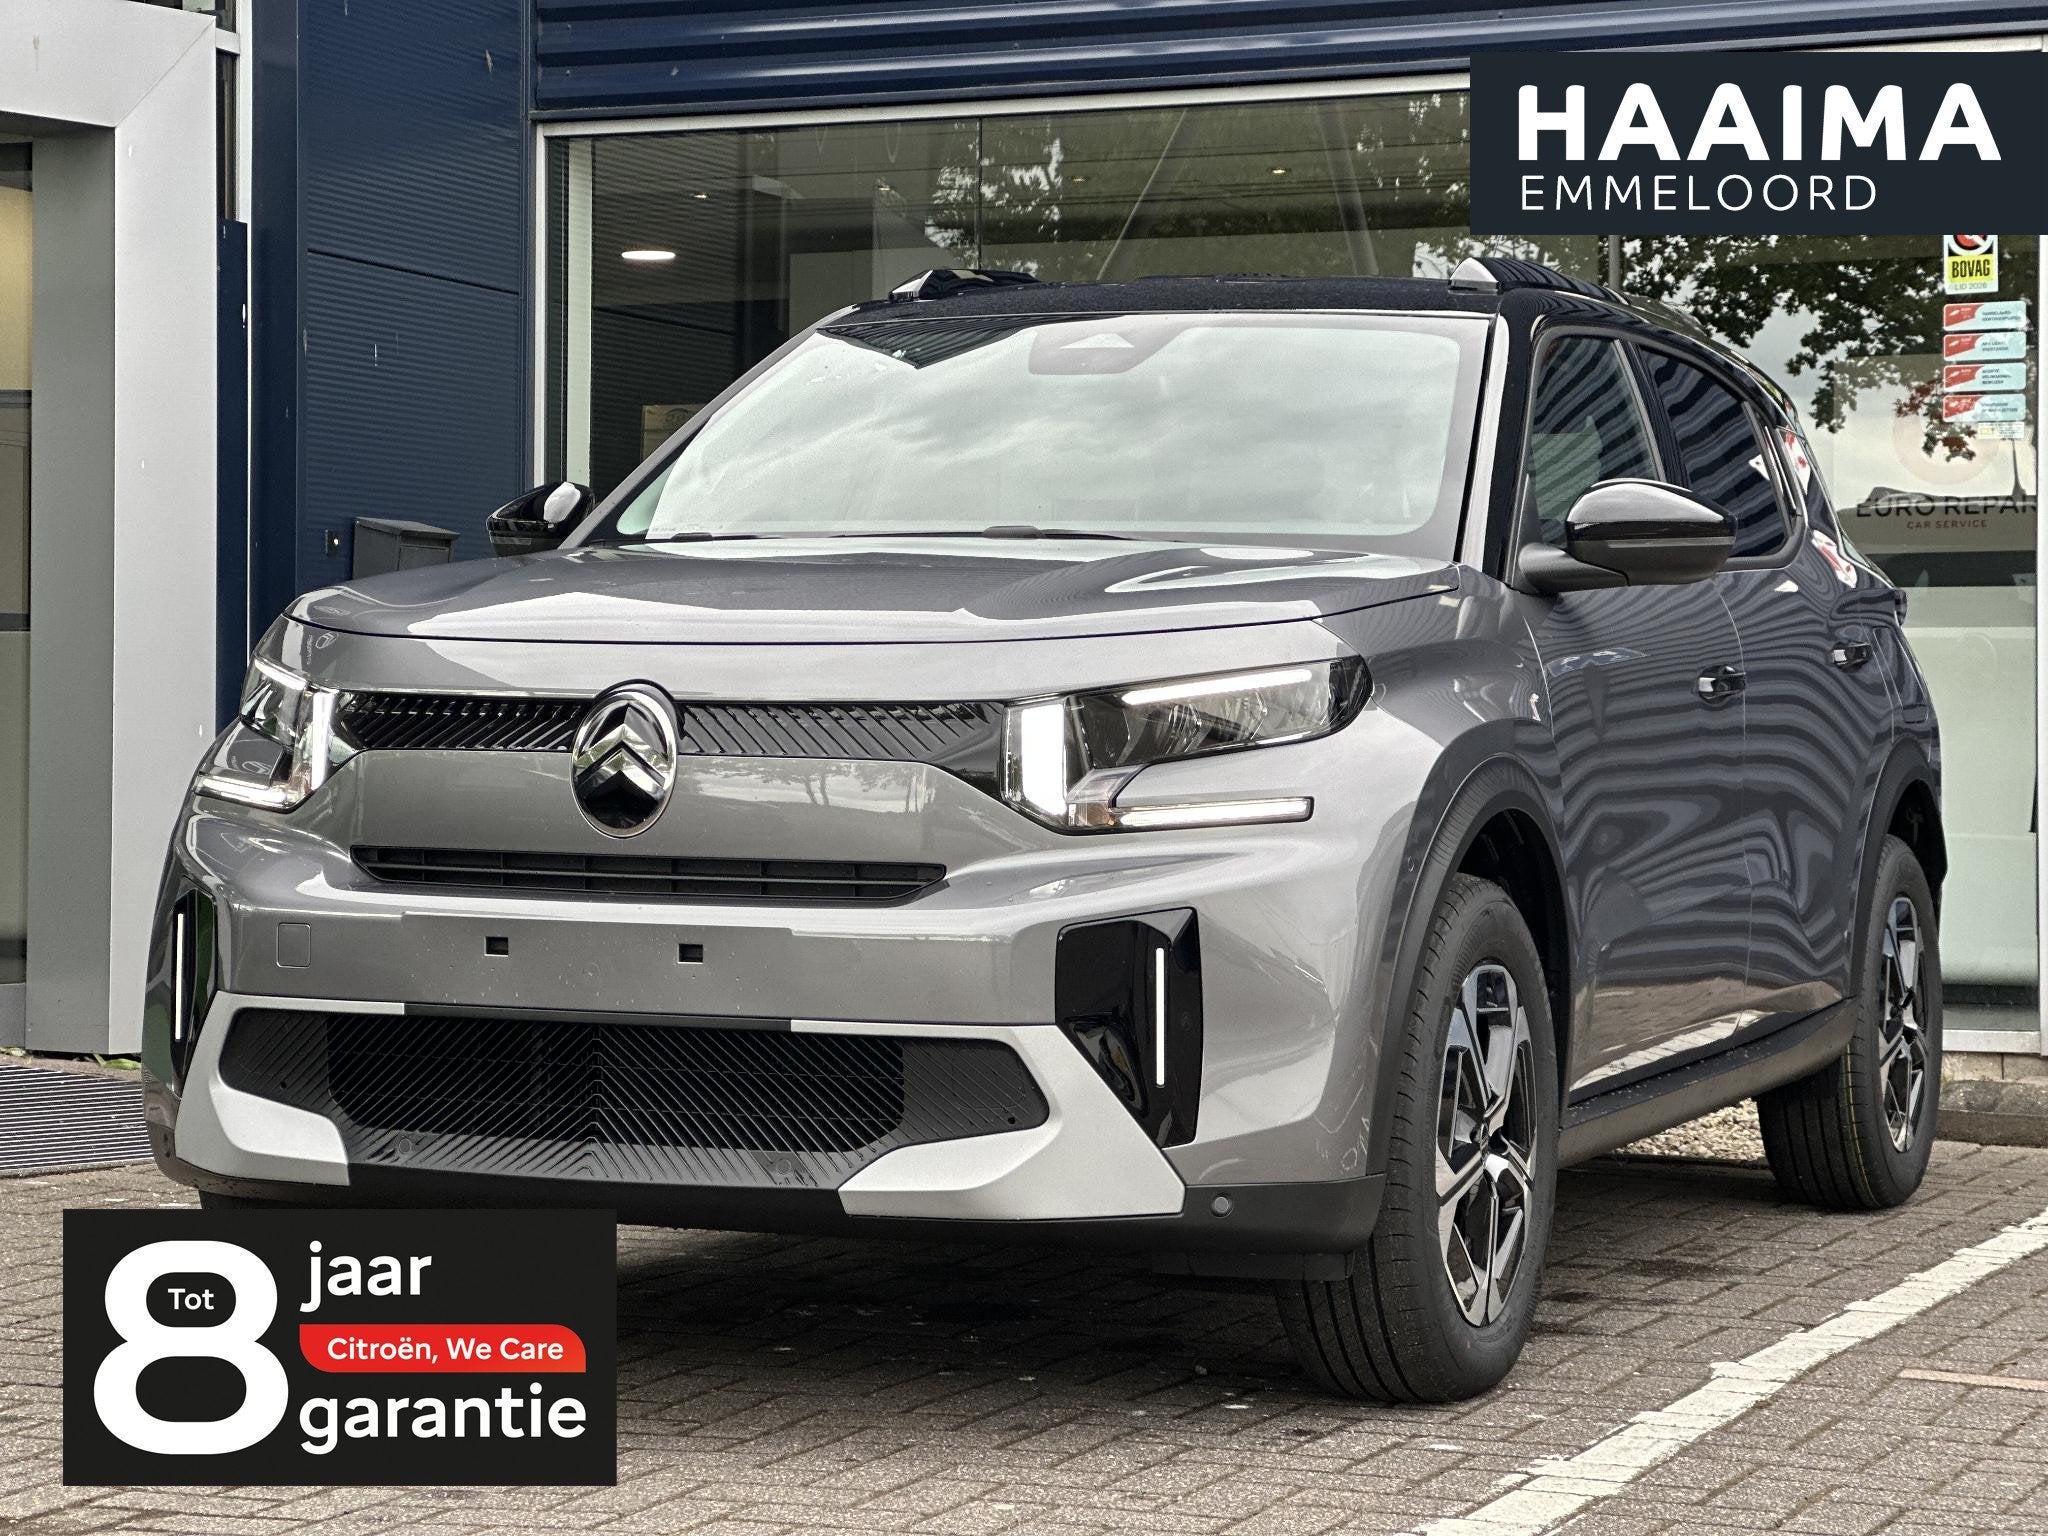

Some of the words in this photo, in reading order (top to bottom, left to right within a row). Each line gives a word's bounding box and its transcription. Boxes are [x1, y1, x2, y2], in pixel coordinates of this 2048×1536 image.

[1951, 259, 1990, 278] BOVAG
[1856, 496, 1935, 517] EURO
[1906, 520, 1931, 529] CAR
[1936, 519, 1987, 528] SERVICE
